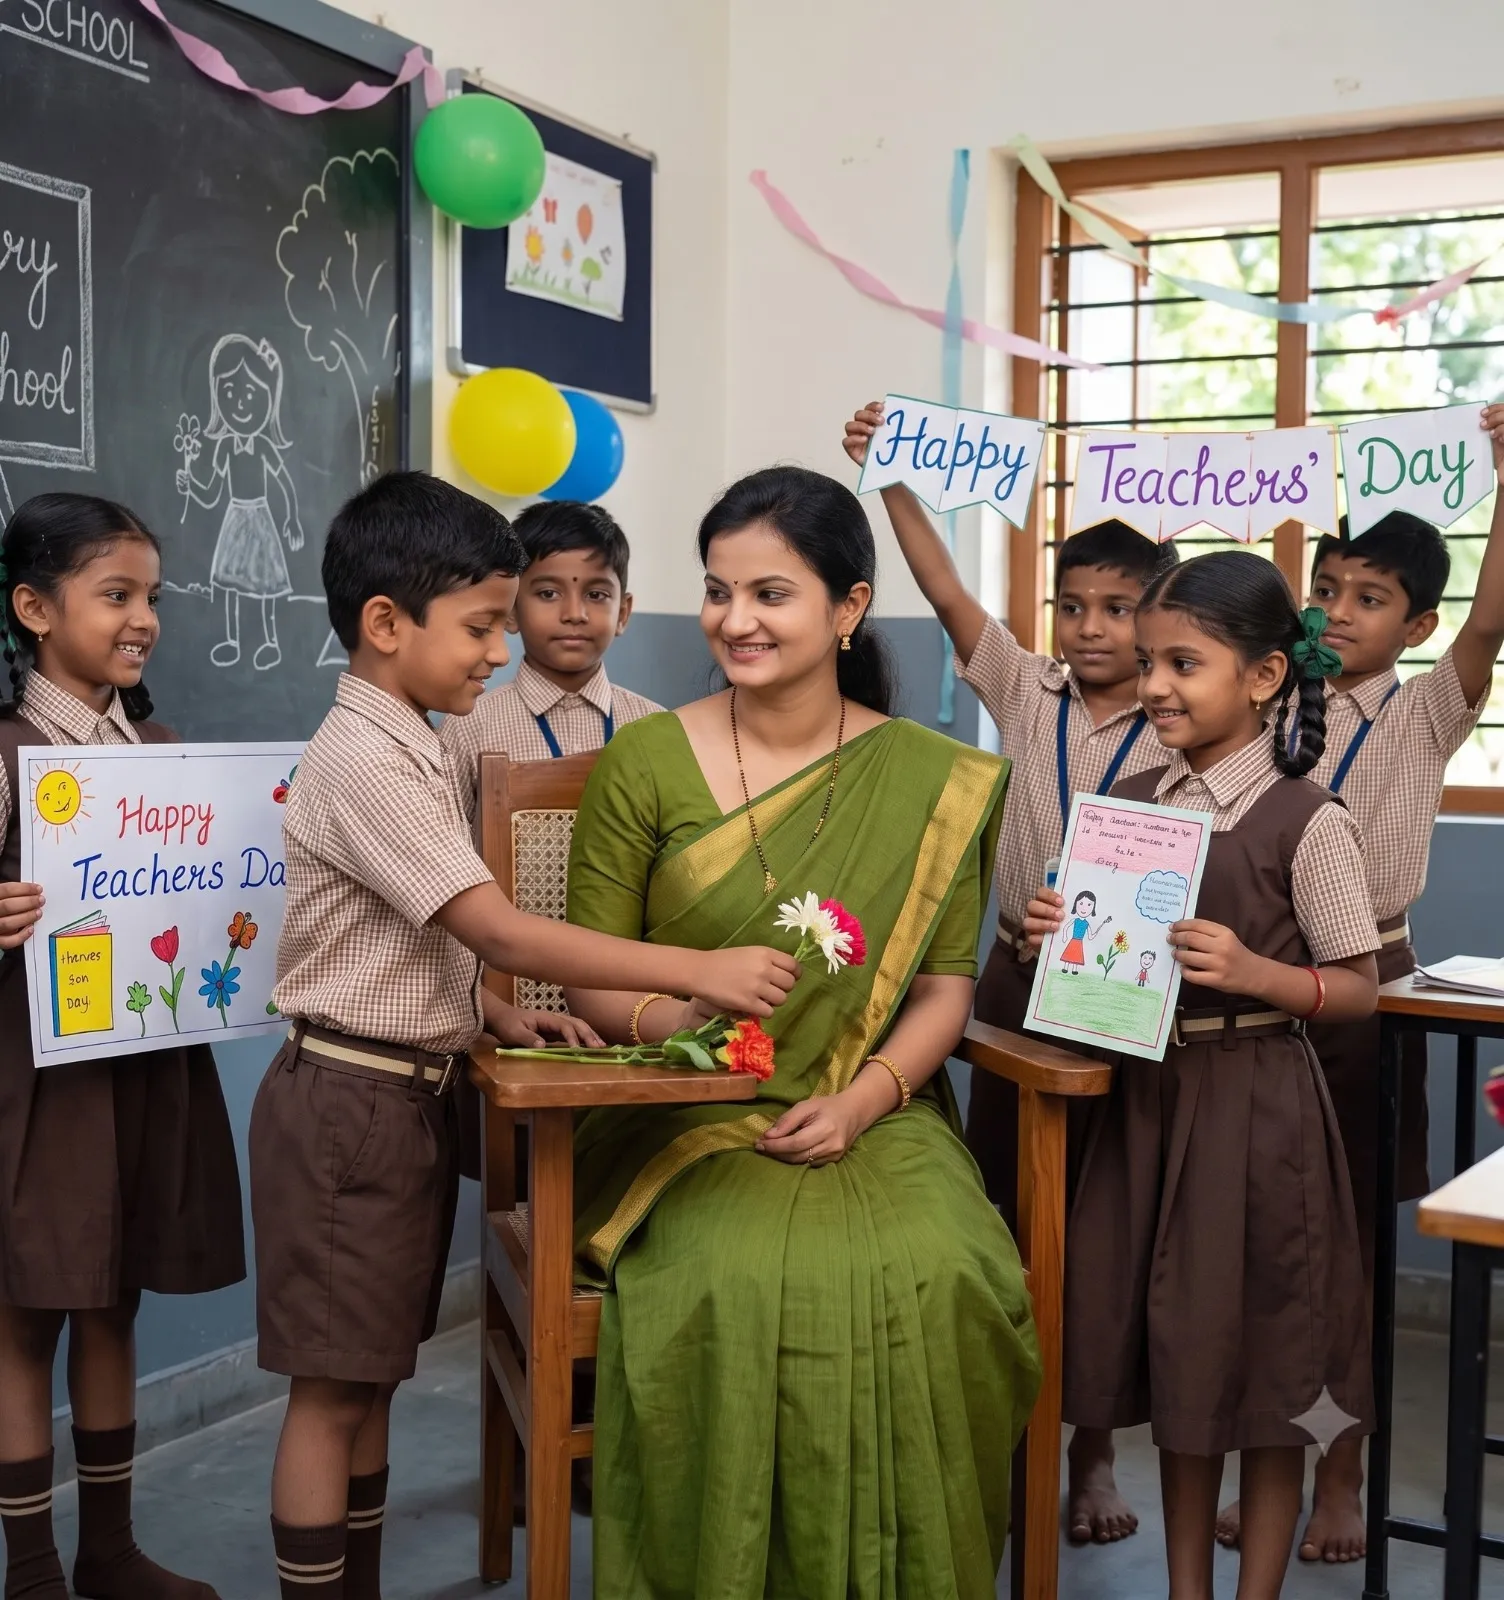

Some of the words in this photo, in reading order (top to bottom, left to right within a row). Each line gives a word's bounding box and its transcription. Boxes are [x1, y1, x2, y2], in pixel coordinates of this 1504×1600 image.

[22, 0, 148, 69] SCHOOL
[876, 409, 1031, 502] Happy
[1357, 435, 1475, 510] Day
[116, 794, 215, 846] Happy
[72, 852, 224, 901] Teachers
